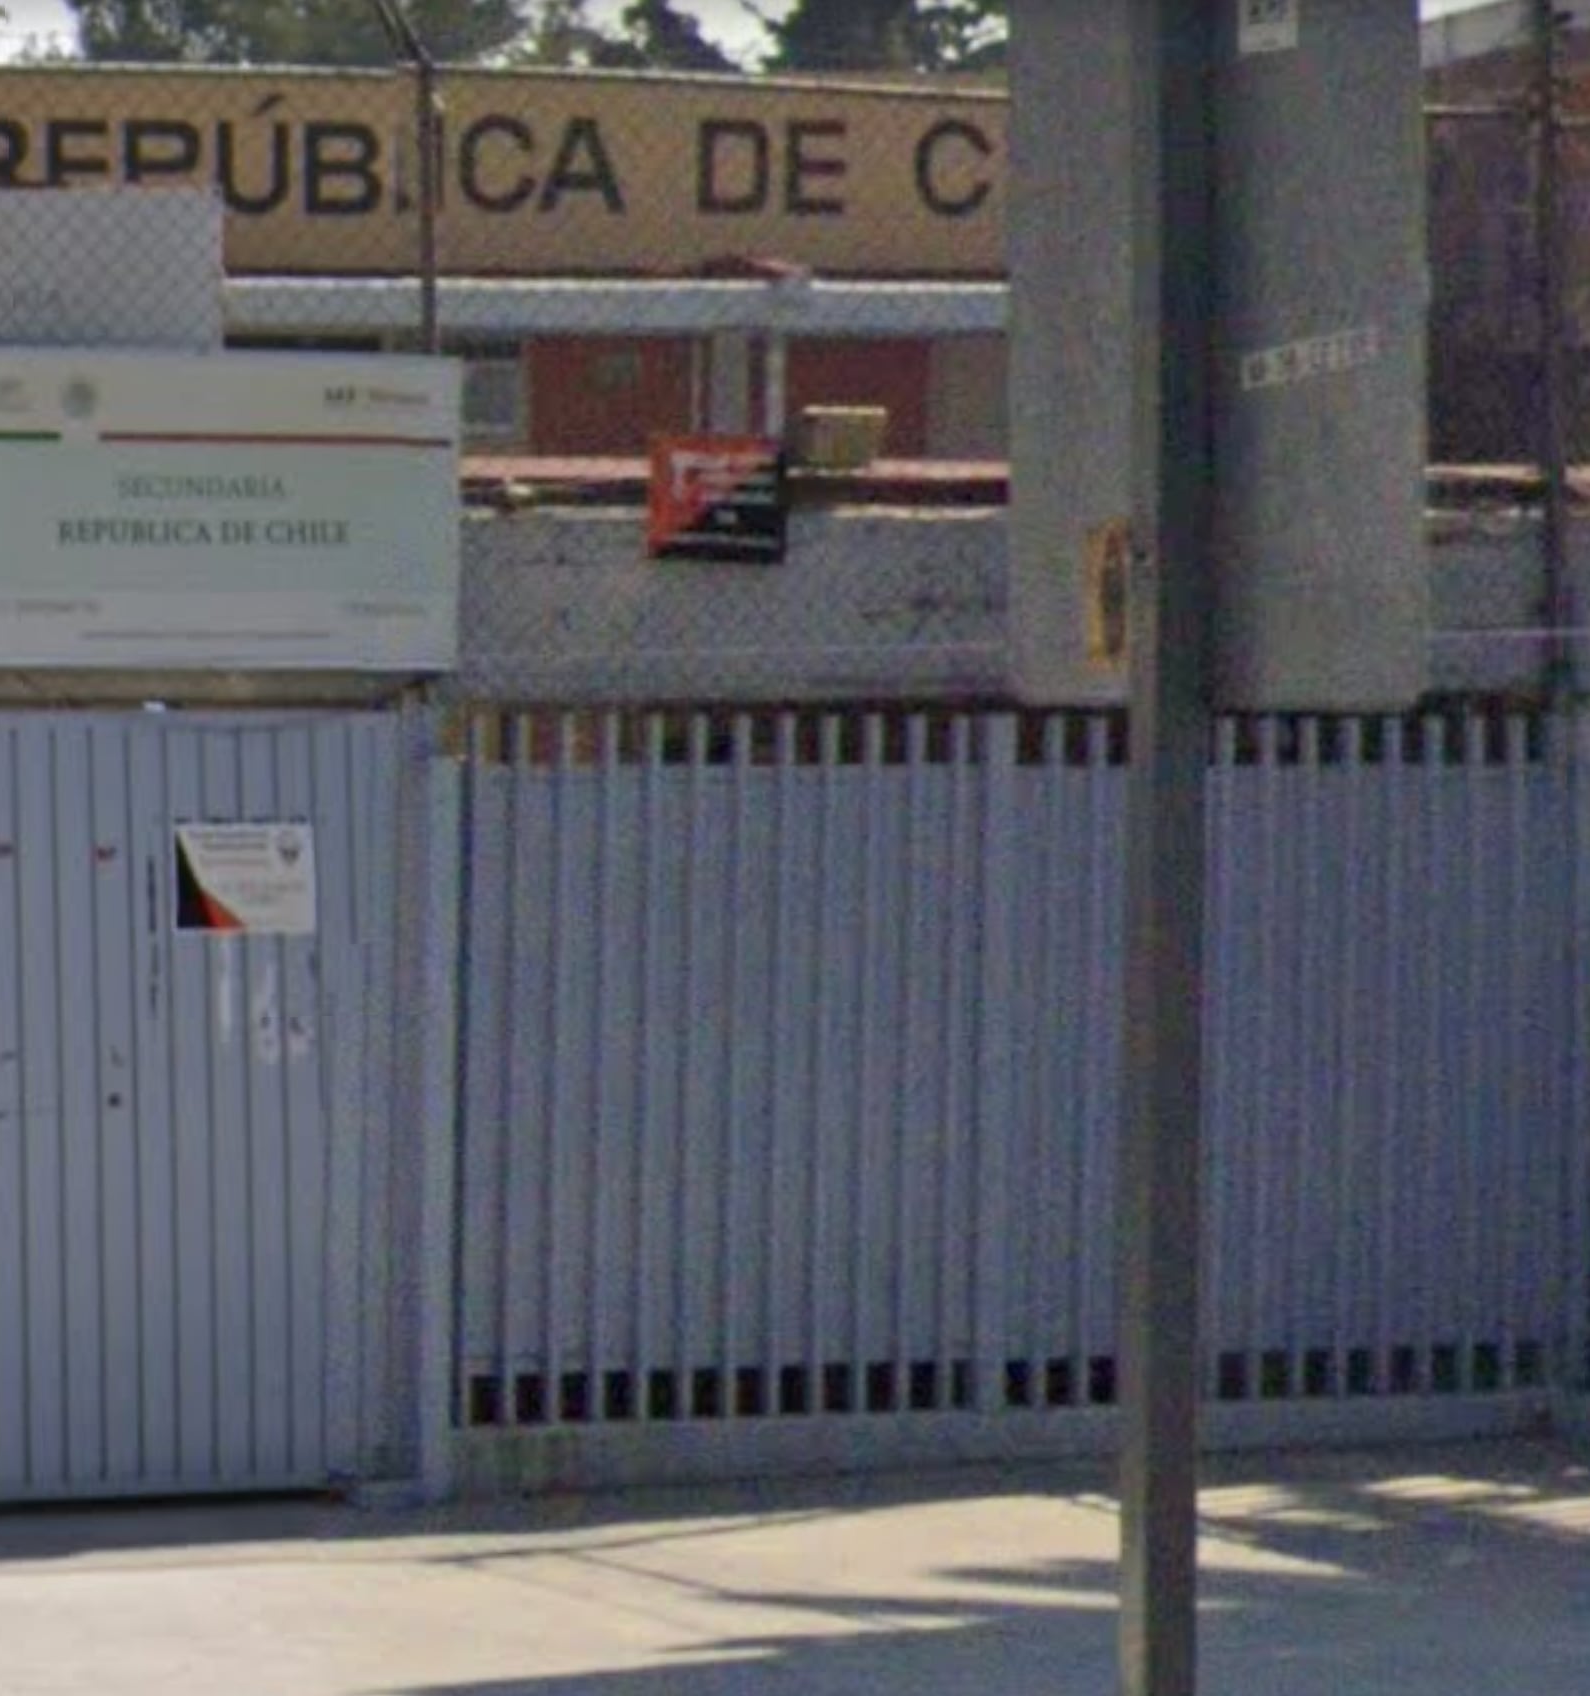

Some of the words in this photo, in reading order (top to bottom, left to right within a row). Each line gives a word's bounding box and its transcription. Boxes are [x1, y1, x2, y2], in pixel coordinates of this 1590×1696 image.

[697, 118, 847, 215] DE
[116, 474, 286, 498] SECUNDARIA
[220, 519, 257, 546] DE
[265, 519, 350, 546] CHILE
